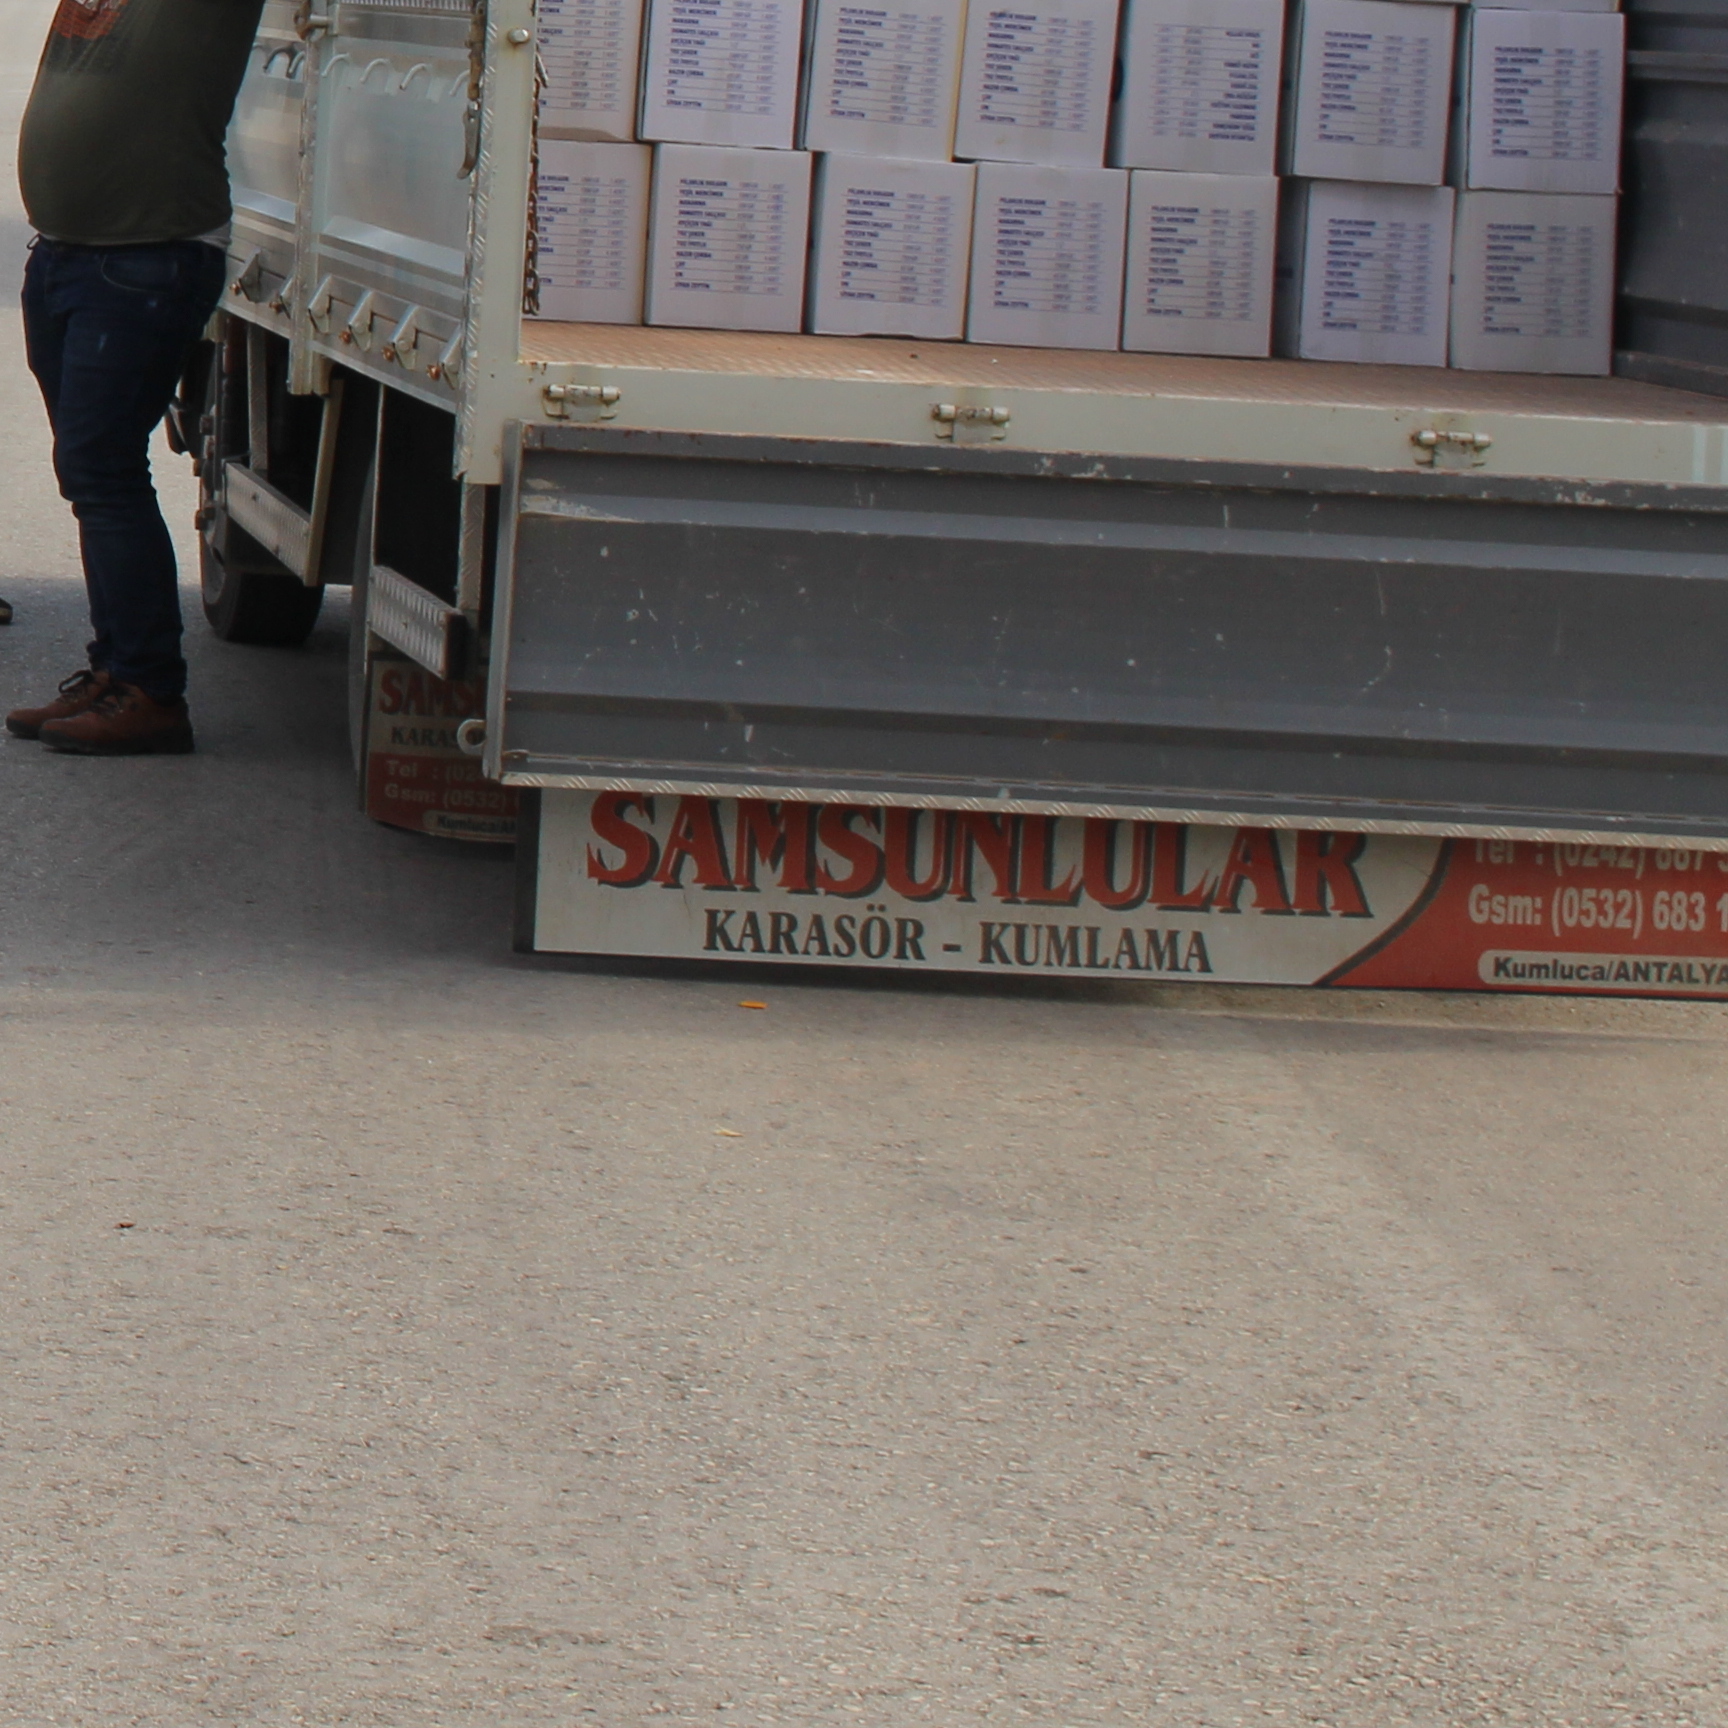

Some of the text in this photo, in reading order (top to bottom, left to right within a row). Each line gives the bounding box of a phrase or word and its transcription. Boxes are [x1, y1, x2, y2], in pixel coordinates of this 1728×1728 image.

[587, 789, 1373, 918] SAMSUNLULAR
[703, 903, 926, 961] KARASÖR
[978, 921, 1213, 972] KUMLAMA
[1468, 884, 1542, 926] Gsm:
[1552, 887, 1642, 940] (0532)
[1652, 890, 1706, 932] 683
